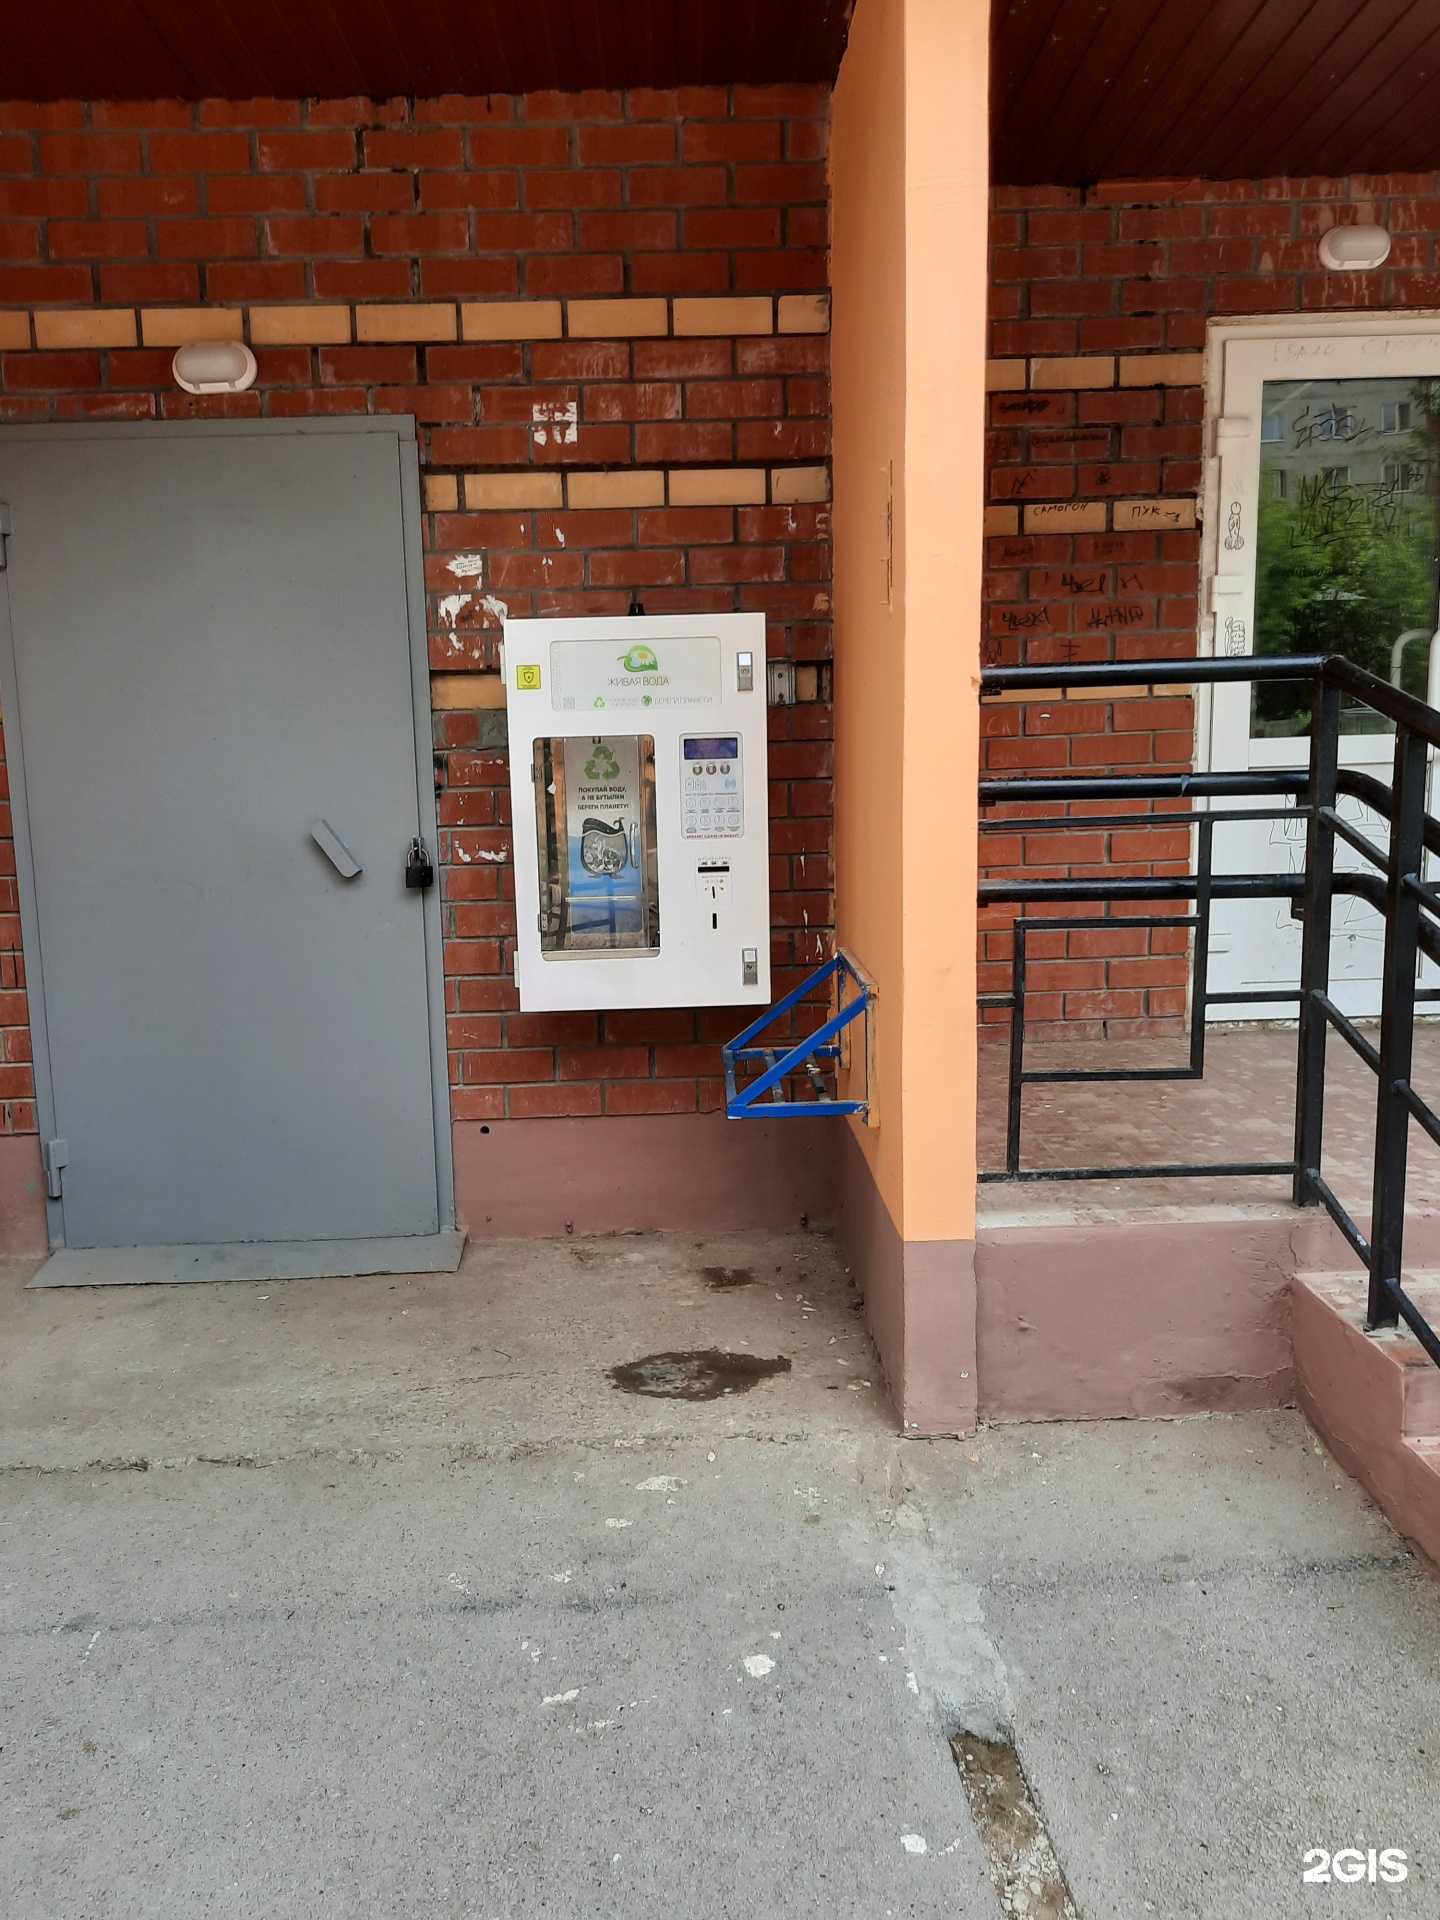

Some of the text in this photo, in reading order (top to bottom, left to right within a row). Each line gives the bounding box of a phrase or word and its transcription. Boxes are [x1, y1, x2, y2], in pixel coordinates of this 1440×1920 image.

[1033, 502, 1089, 516] САМОГОН
[1131, 505, 1160, 519] ПУК
[608, 675, 670, 687] ЖИВАЯ ВОДА
